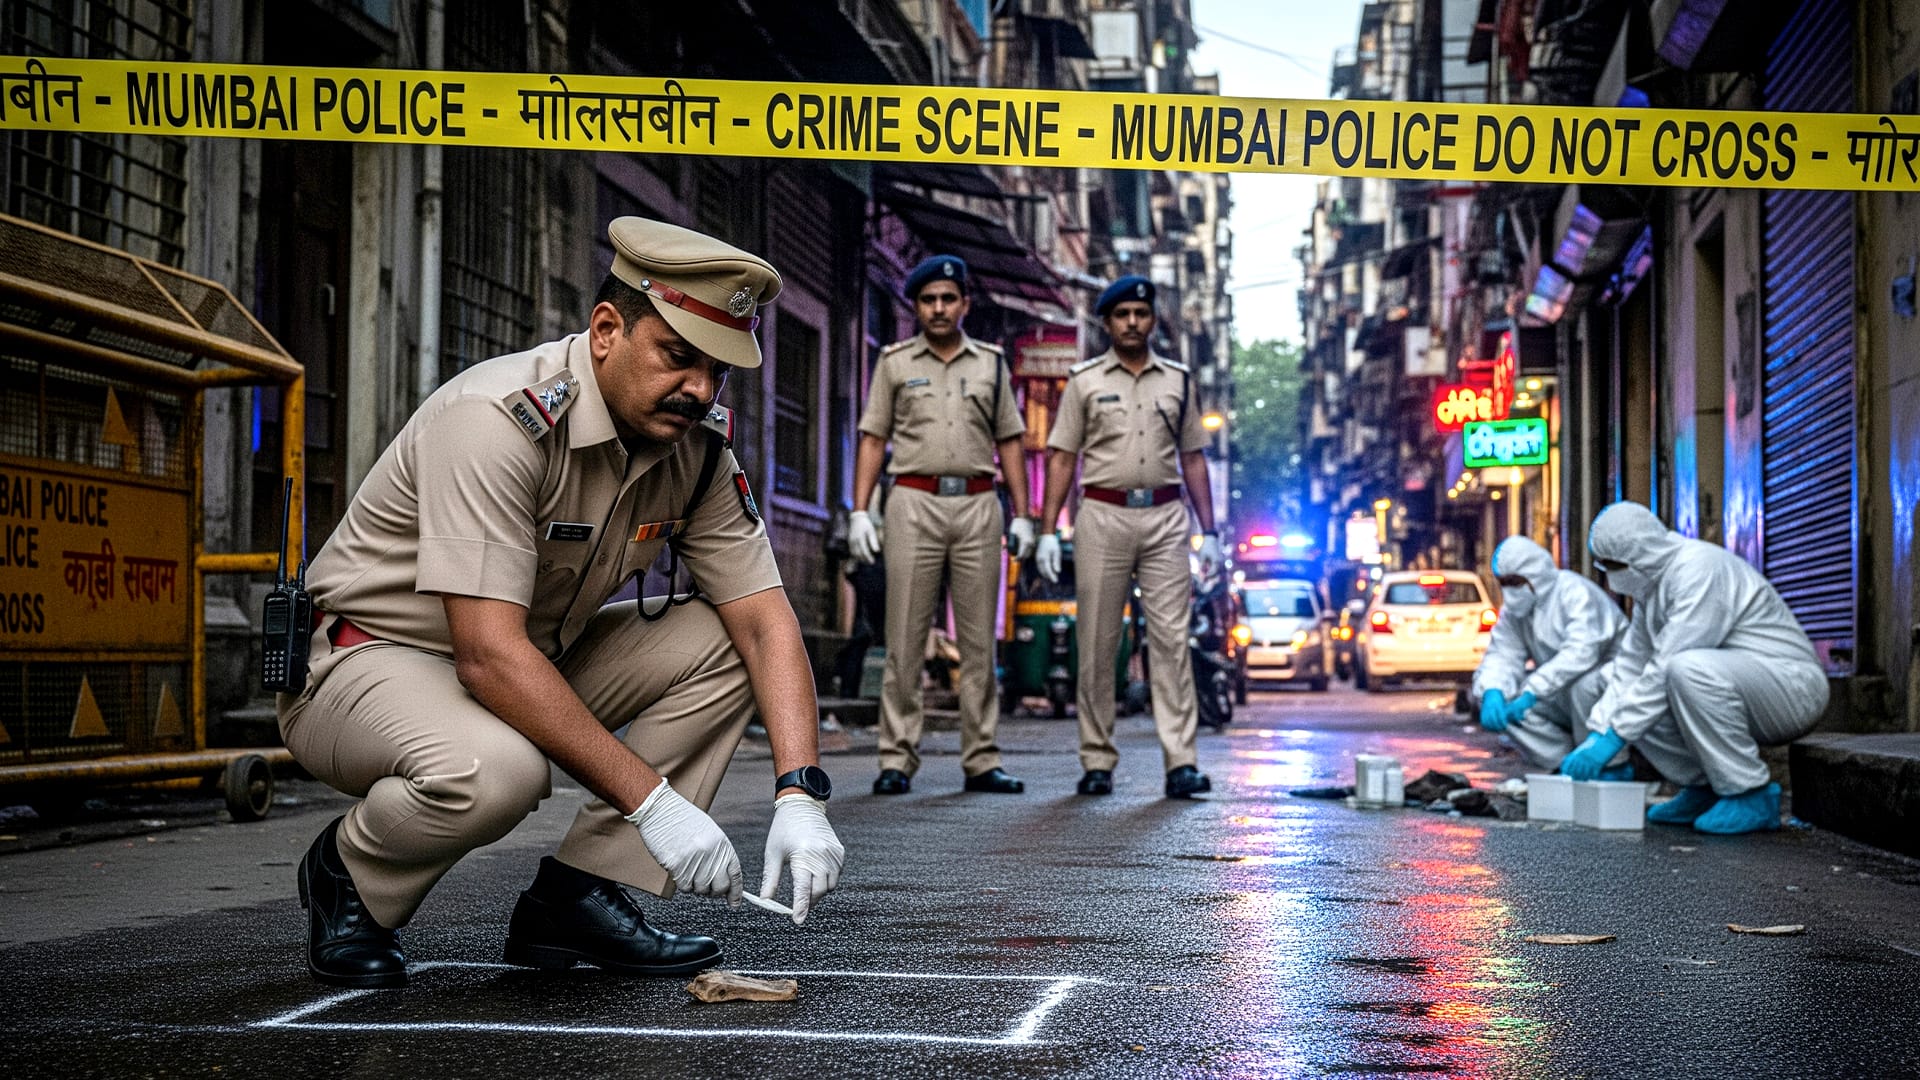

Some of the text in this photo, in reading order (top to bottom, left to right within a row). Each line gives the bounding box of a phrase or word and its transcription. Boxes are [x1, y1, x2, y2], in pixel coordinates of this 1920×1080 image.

[126, 72, 298, 131] MUMBAI
[313, 78, 465, 137] POLICE
[766, 93, 900, 152] CRIME
[916, 97, 1060, 157] SCENE
[1111, 104, 1287, 165] MUMBAI
[1303, 110, 1458, 170] POLICE
[1473, 115, 1536, 174] DO
[1549, 118, 1641, 176] NOT
[1653, 120, 1798, 181] CROSS
[41, 480, 108, 527] POLICE
